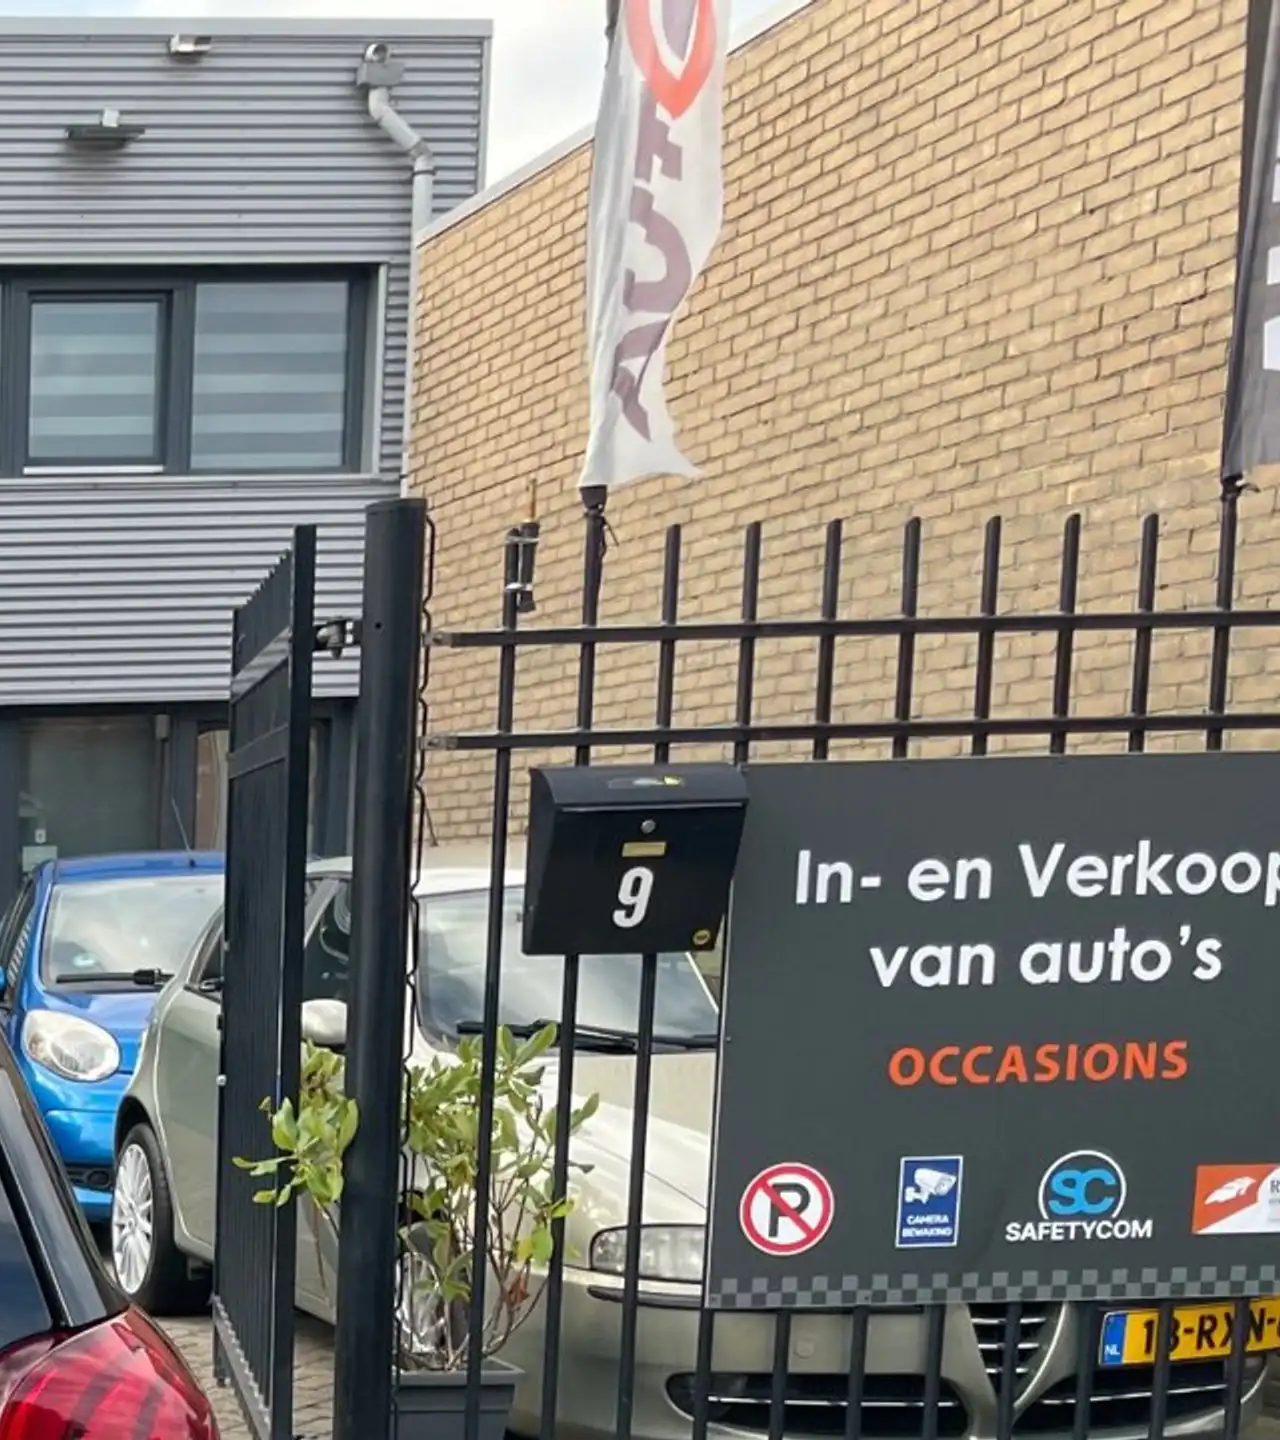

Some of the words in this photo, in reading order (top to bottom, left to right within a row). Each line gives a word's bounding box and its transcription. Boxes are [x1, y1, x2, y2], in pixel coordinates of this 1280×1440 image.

[612, 866, 654, 928] 9
[795, 850, 882, 904] In-
[907, 856, 993, 901] en
[869, 943, 996, 987] van
[1019, 924, 1223, 985] auto's
[888, 1040, 1189, 1086] OCCASIONS
[1005, 1219, 1153, 1242] SAFETYCOM
